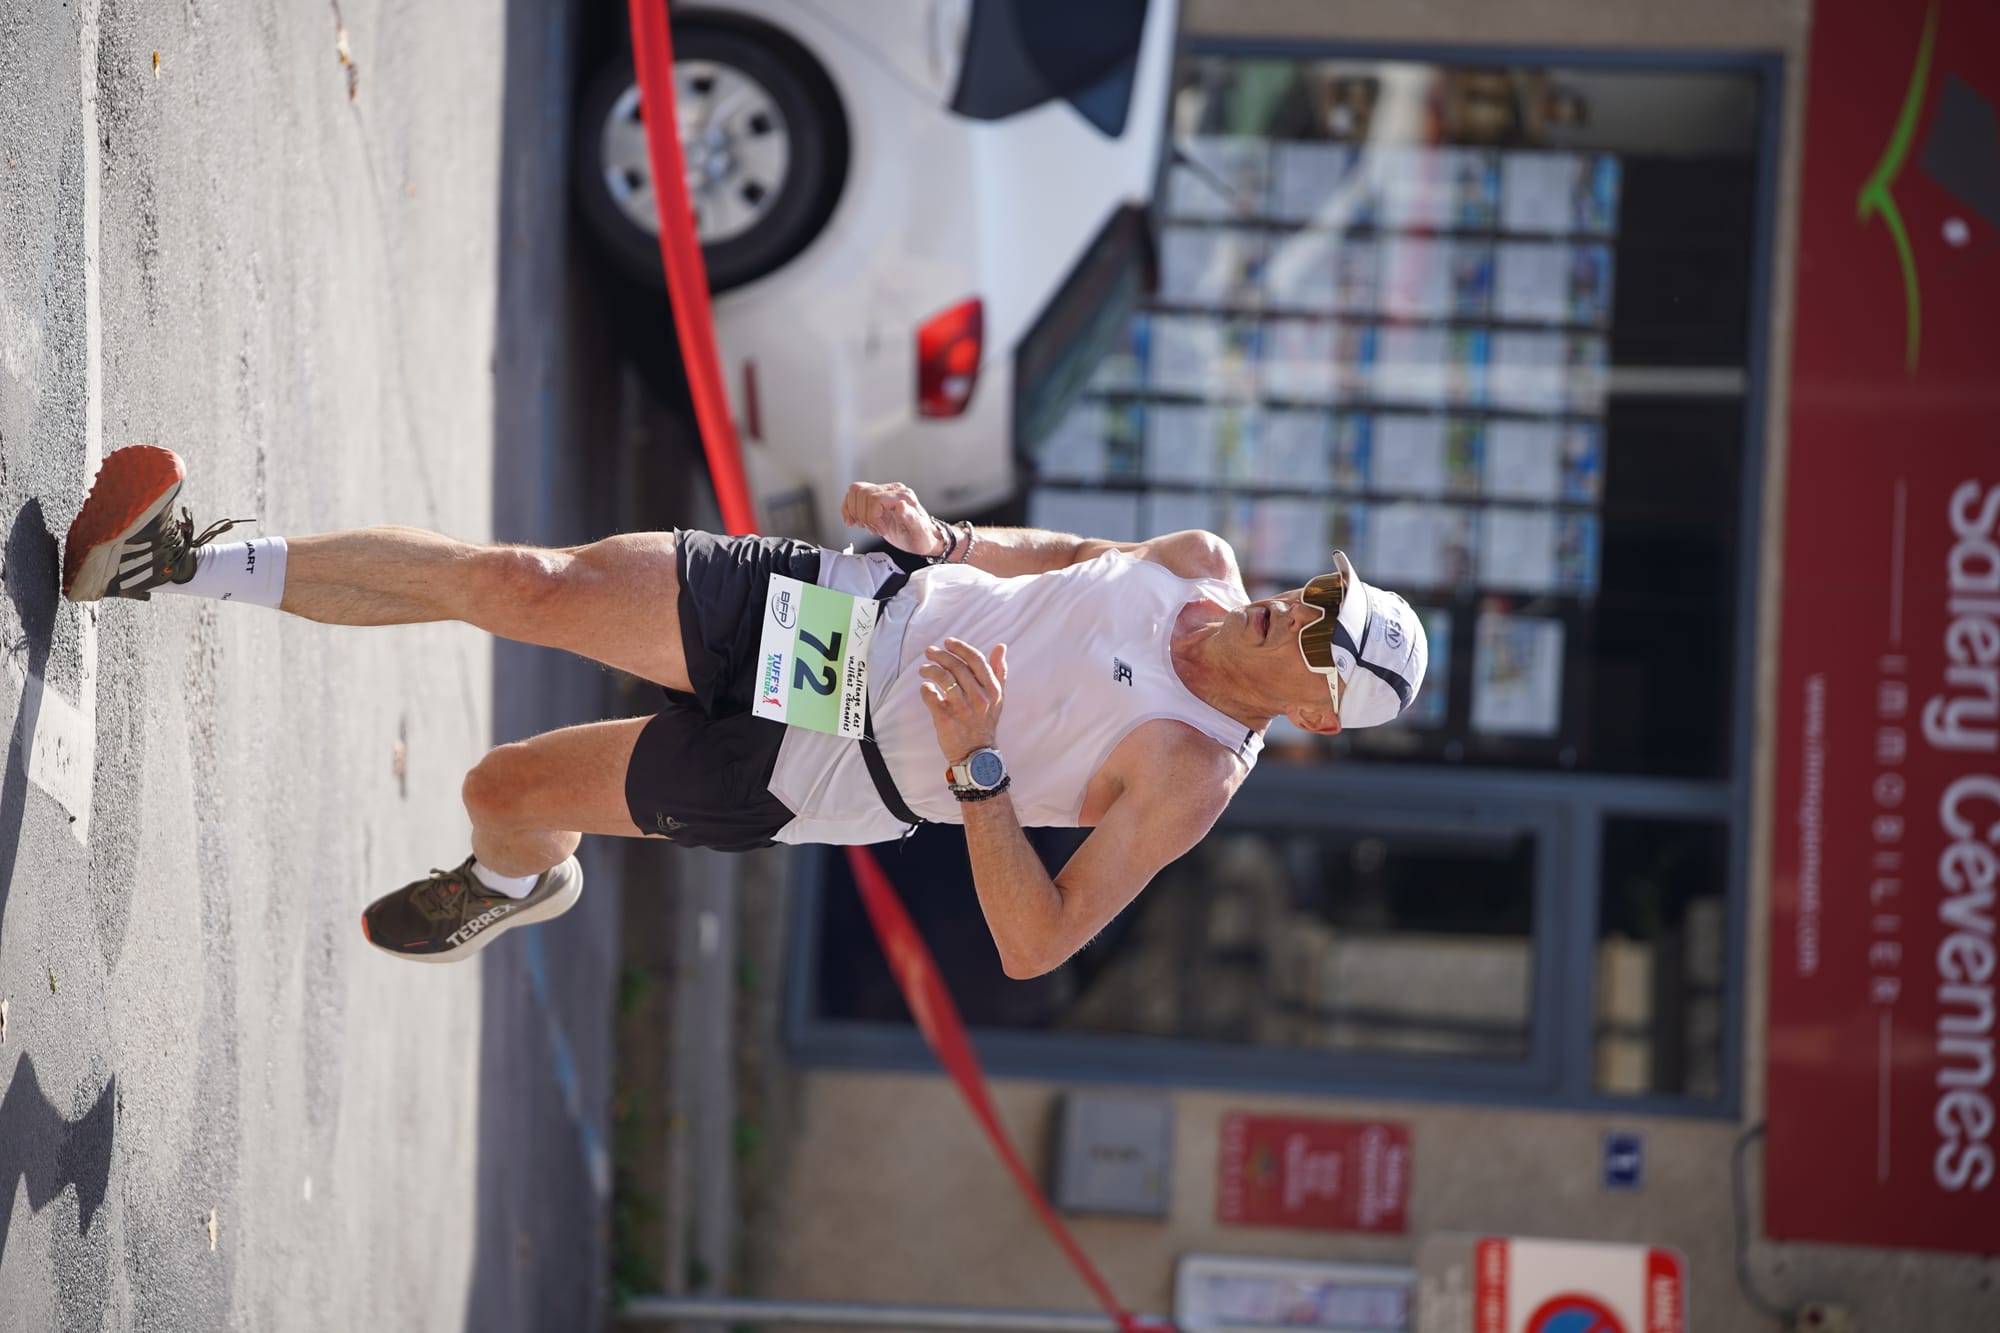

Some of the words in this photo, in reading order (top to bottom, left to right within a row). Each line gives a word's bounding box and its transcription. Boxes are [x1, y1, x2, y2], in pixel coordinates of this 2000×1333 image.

[779, 591, 790, 623] BFP
[763, 654, 775, 696] Aventure
[769, 653, 783, 694] TUFF'S
[793, 629, 842, 696] 72
[852, 661, 866, 707] Challenge
[843, 693, 854, 732] cévenoles
[853, 713, 861, 728] des
[1869, 655, 1908, 1003] IMMOBILIER
[445, 903, 517, 946] TERREX
